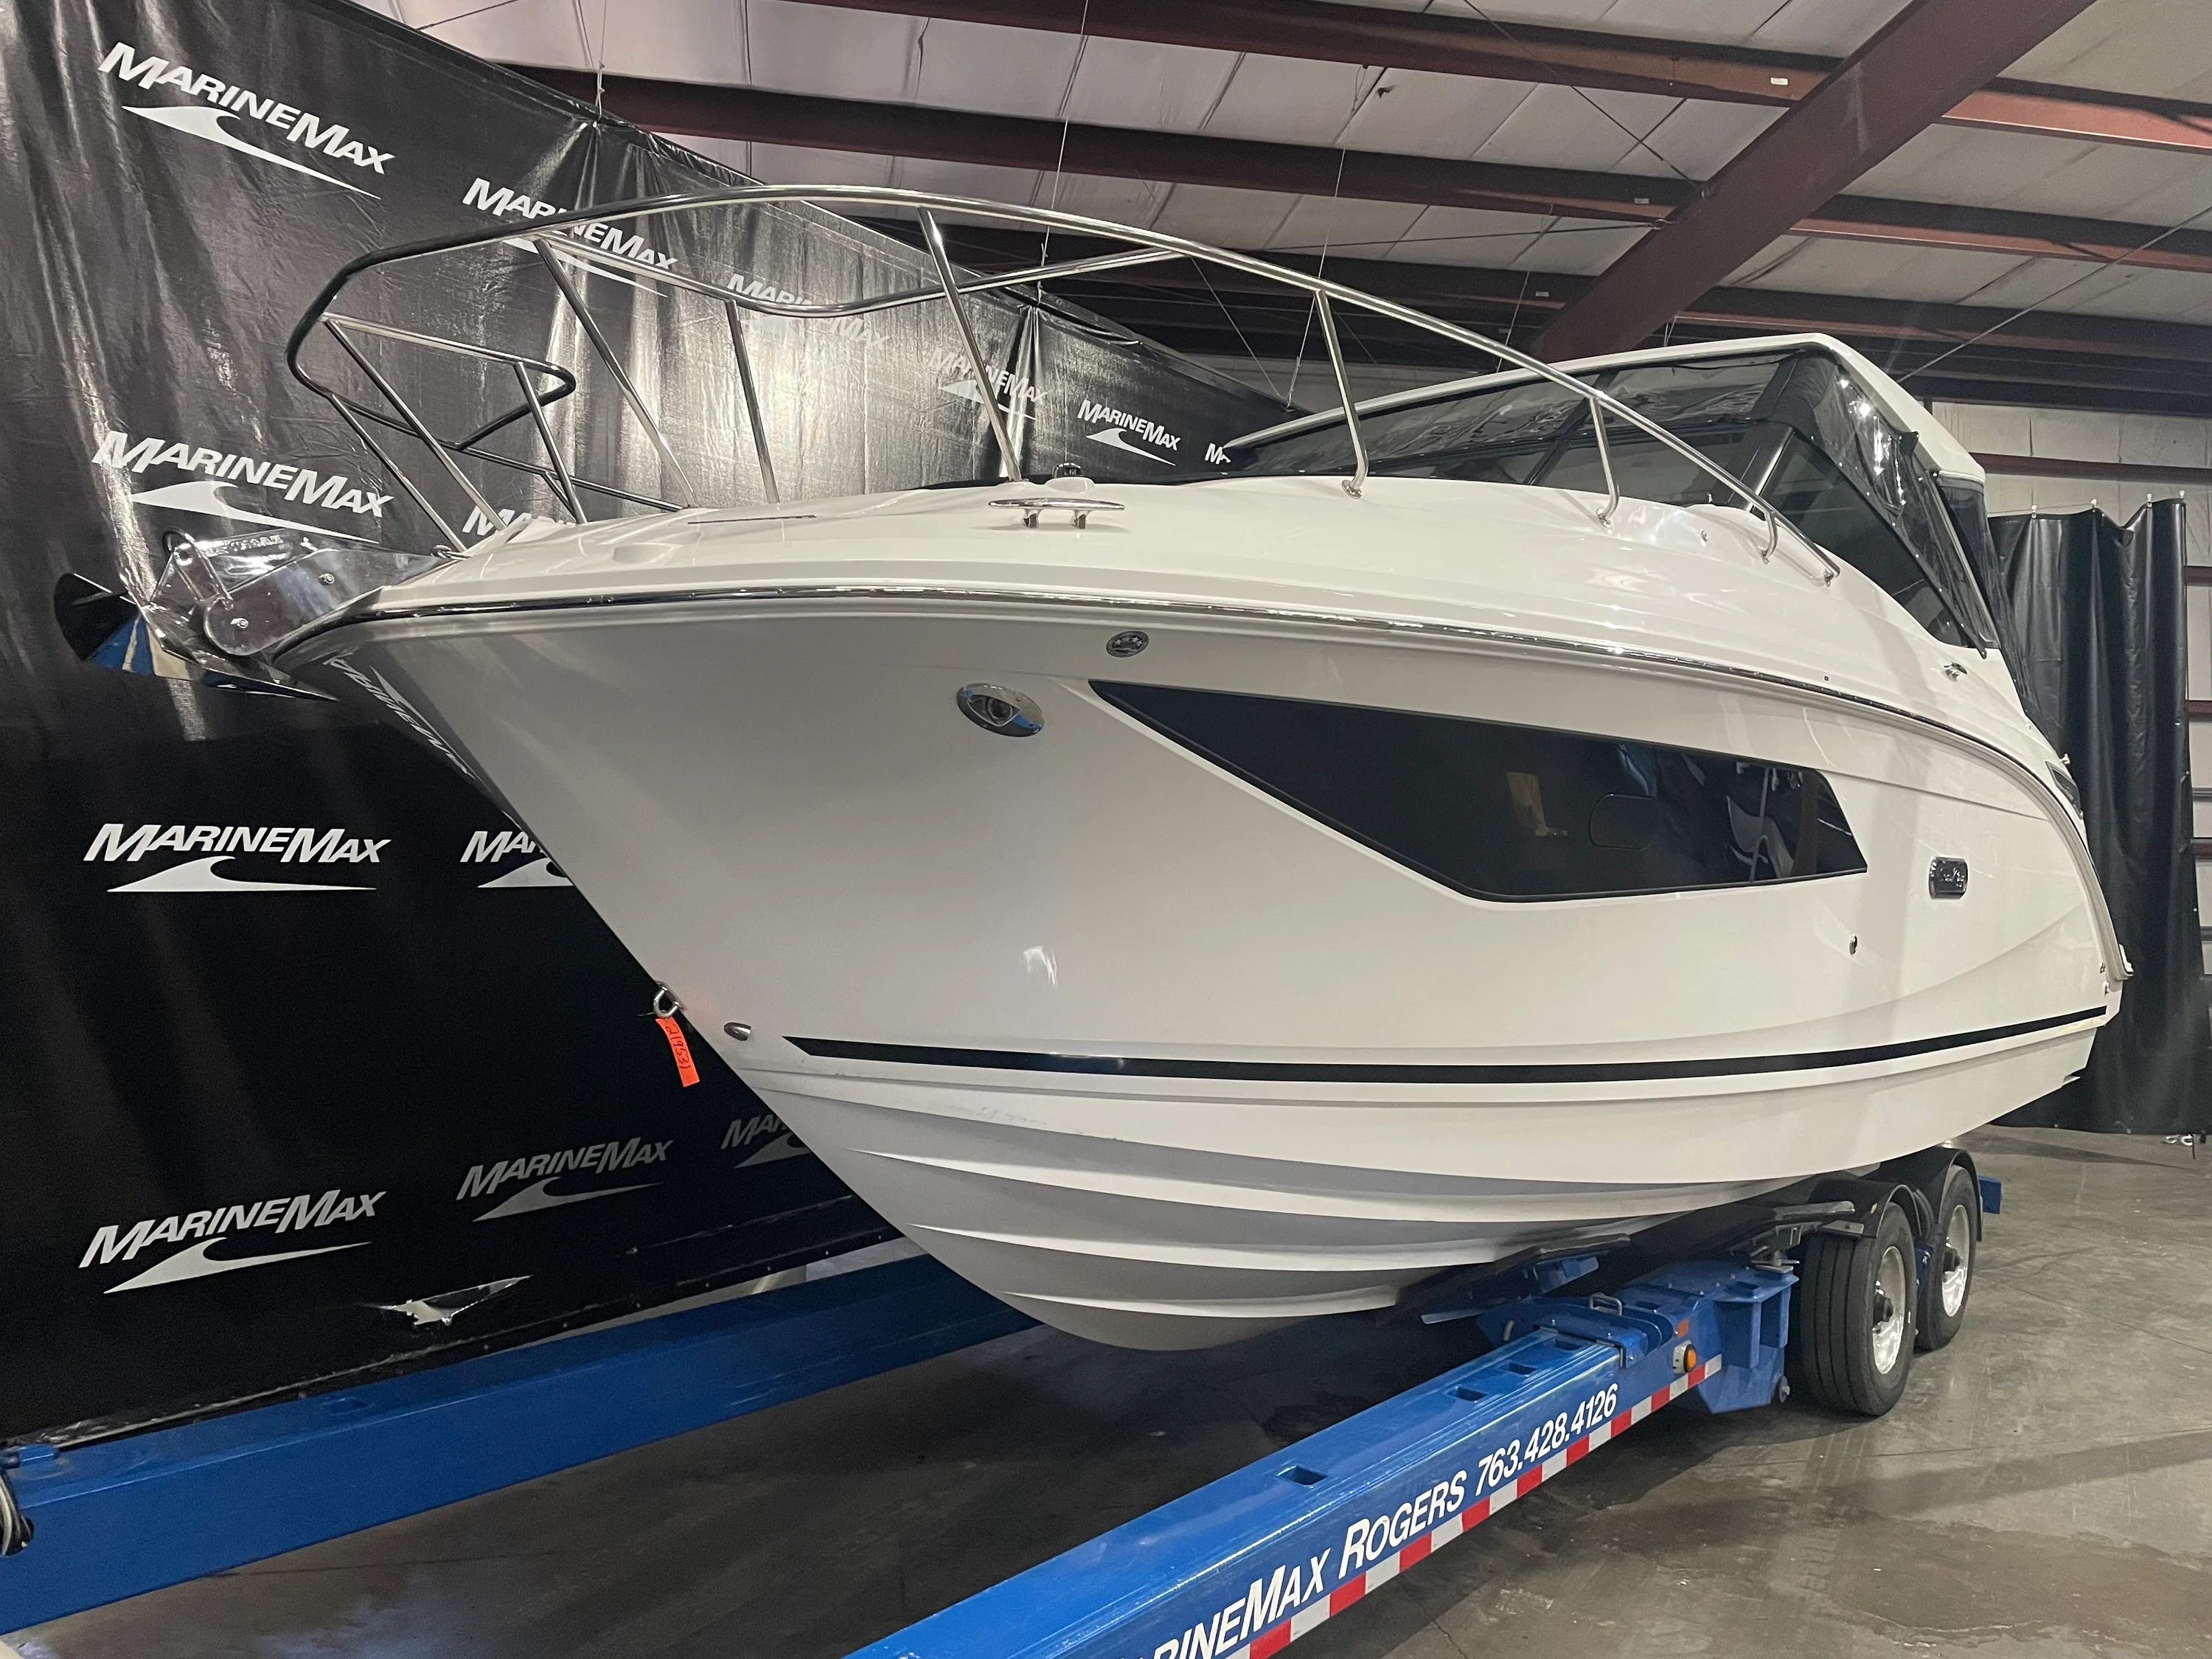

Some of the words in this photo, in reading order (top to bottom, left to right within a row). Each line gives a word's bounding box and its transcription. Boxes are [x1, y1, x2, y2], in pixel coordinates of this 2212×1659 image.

[98, 42, 395, 174] MARINEMAX
[1077, 399, 1180, 451] MARINEMAX
[91, 431, 394, 517] MARINEMAX
[83, 823, 391, 863] MARINEMAX
[456, 1137, 674, 1200] MARINEMAX
[79, 1189, 386, 1268] MARINEMAX
[1338, 1470, 1467, 1579] ROGERS
[1475, 1382, 1618, 1497] 763.428.4126
